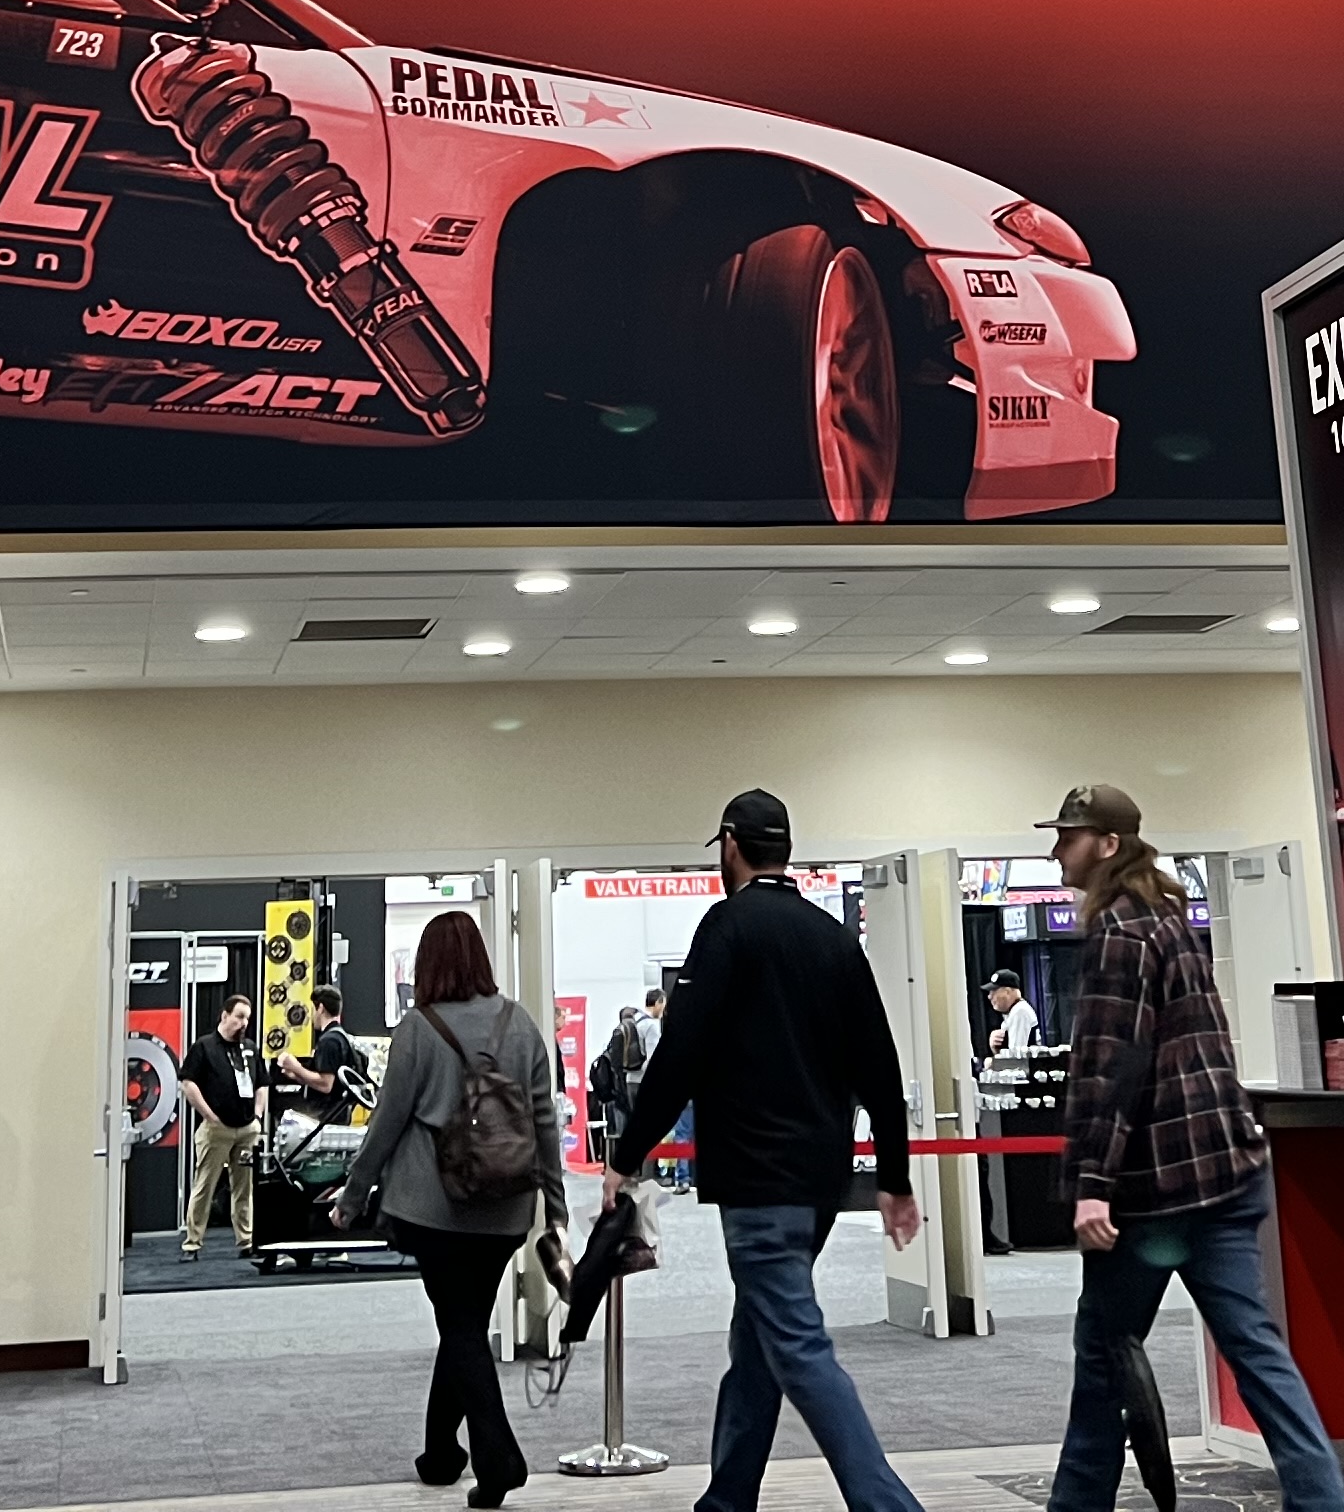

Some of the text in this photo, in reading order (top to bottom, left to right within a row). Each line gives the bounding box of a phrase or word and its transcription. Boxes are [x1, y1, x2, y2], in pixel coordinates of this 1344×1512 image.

[55, 28, 104, 59] 723
[389, 56, 555, 111] PEDAL
[391, 94, 560, 127] COMMANDER
[373, 290, 425, 324] FEAL
[118, 311, 323, 353] BOXO USA
[997, 326, 1048, 341] WISEFAB
[988, 395, 1052, 422] SIKKY
[593, 875, 829, 897] VALVETRAIN ION
